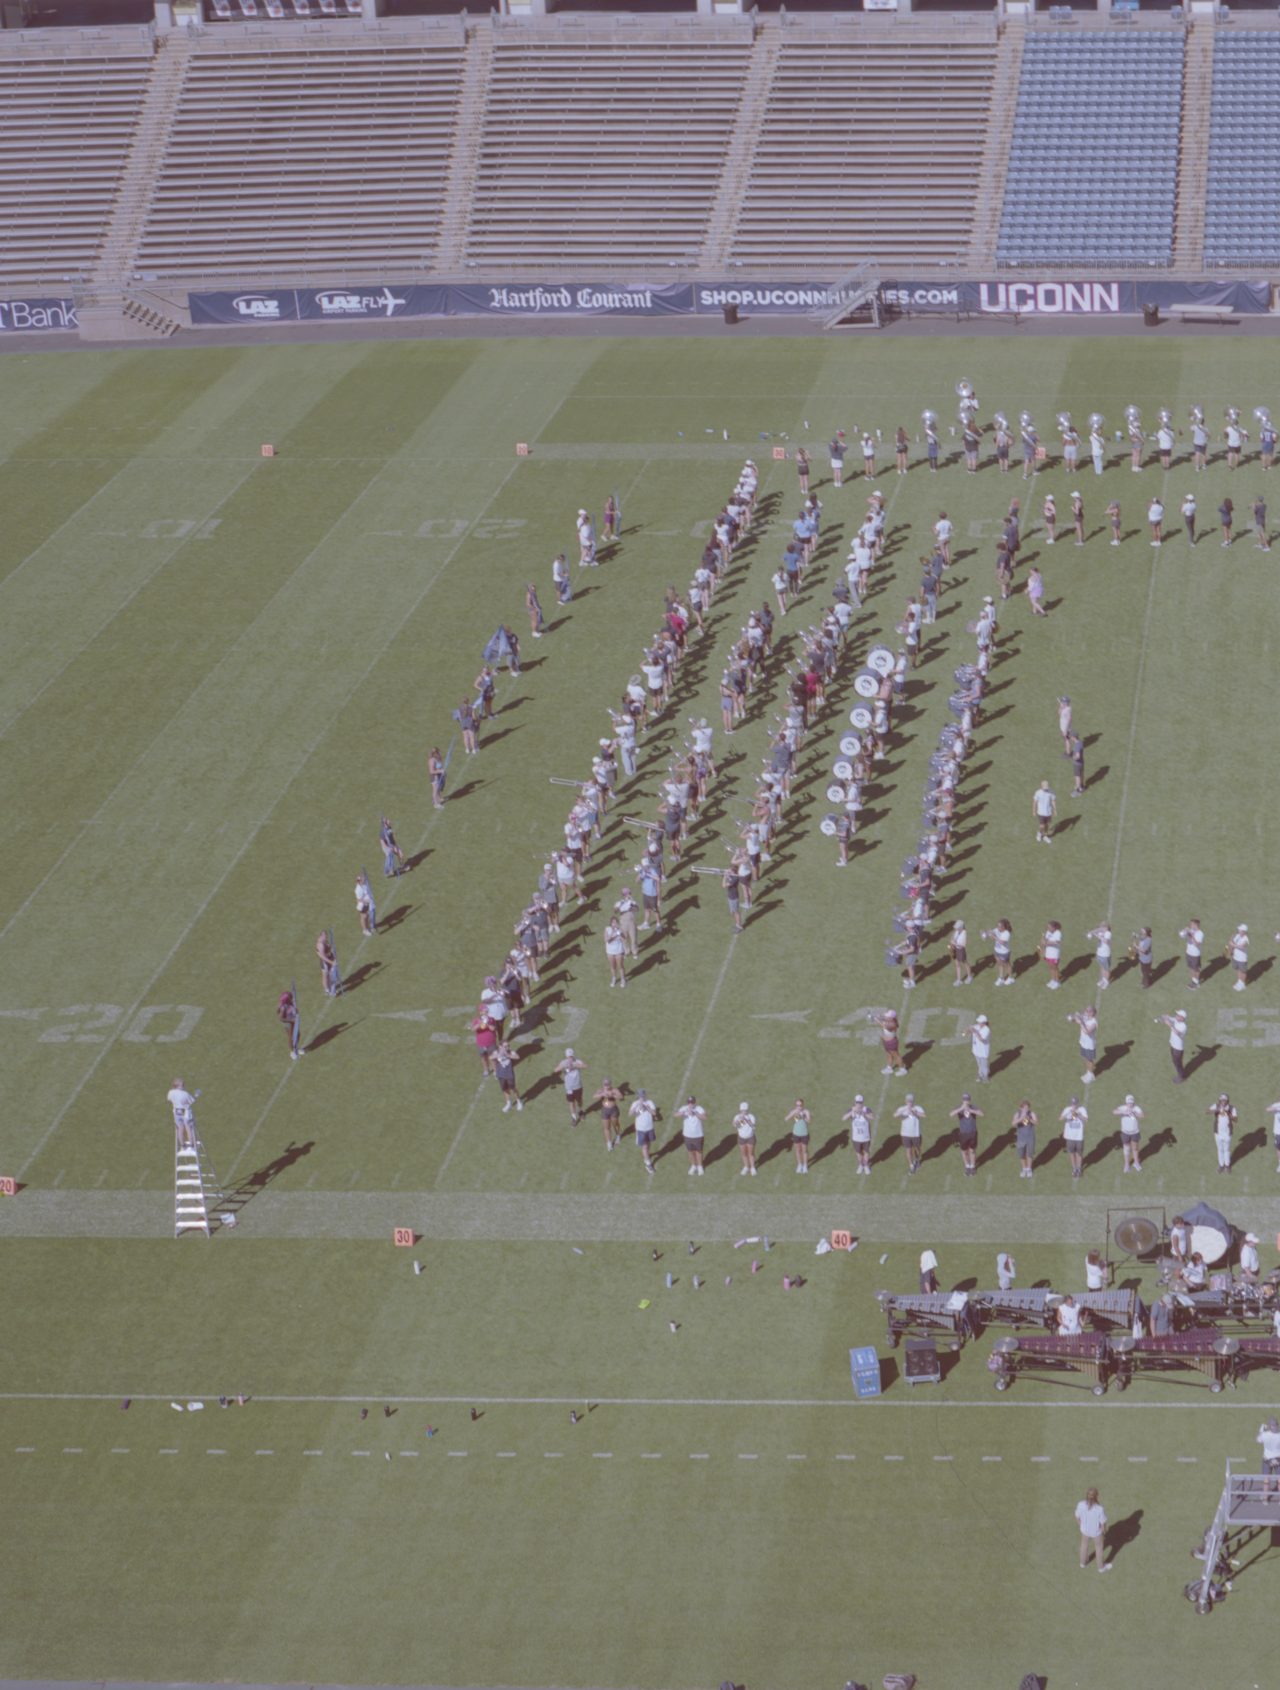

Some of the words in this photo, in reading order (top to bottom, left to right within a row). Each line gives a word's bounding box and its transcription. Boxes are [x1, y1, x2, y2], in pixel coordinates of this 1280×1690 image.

[321, 296, 361, 309] LAZ
[488, 287, 571, 311] Hartford
[576, 288, 653, 308] Courant
[701, 290, 957, 306] SHOP.UCONNHUIES.COM
[980, 283, 1119, 312] UCONN
[239, 300, 279, 315] LAZ
[38, 1004, 206, 1043] 20
[817, 1006, 980, 1046] 40
[396, 1230, 410, 1244] 30
[834, 1233, 848, 1247] 40
